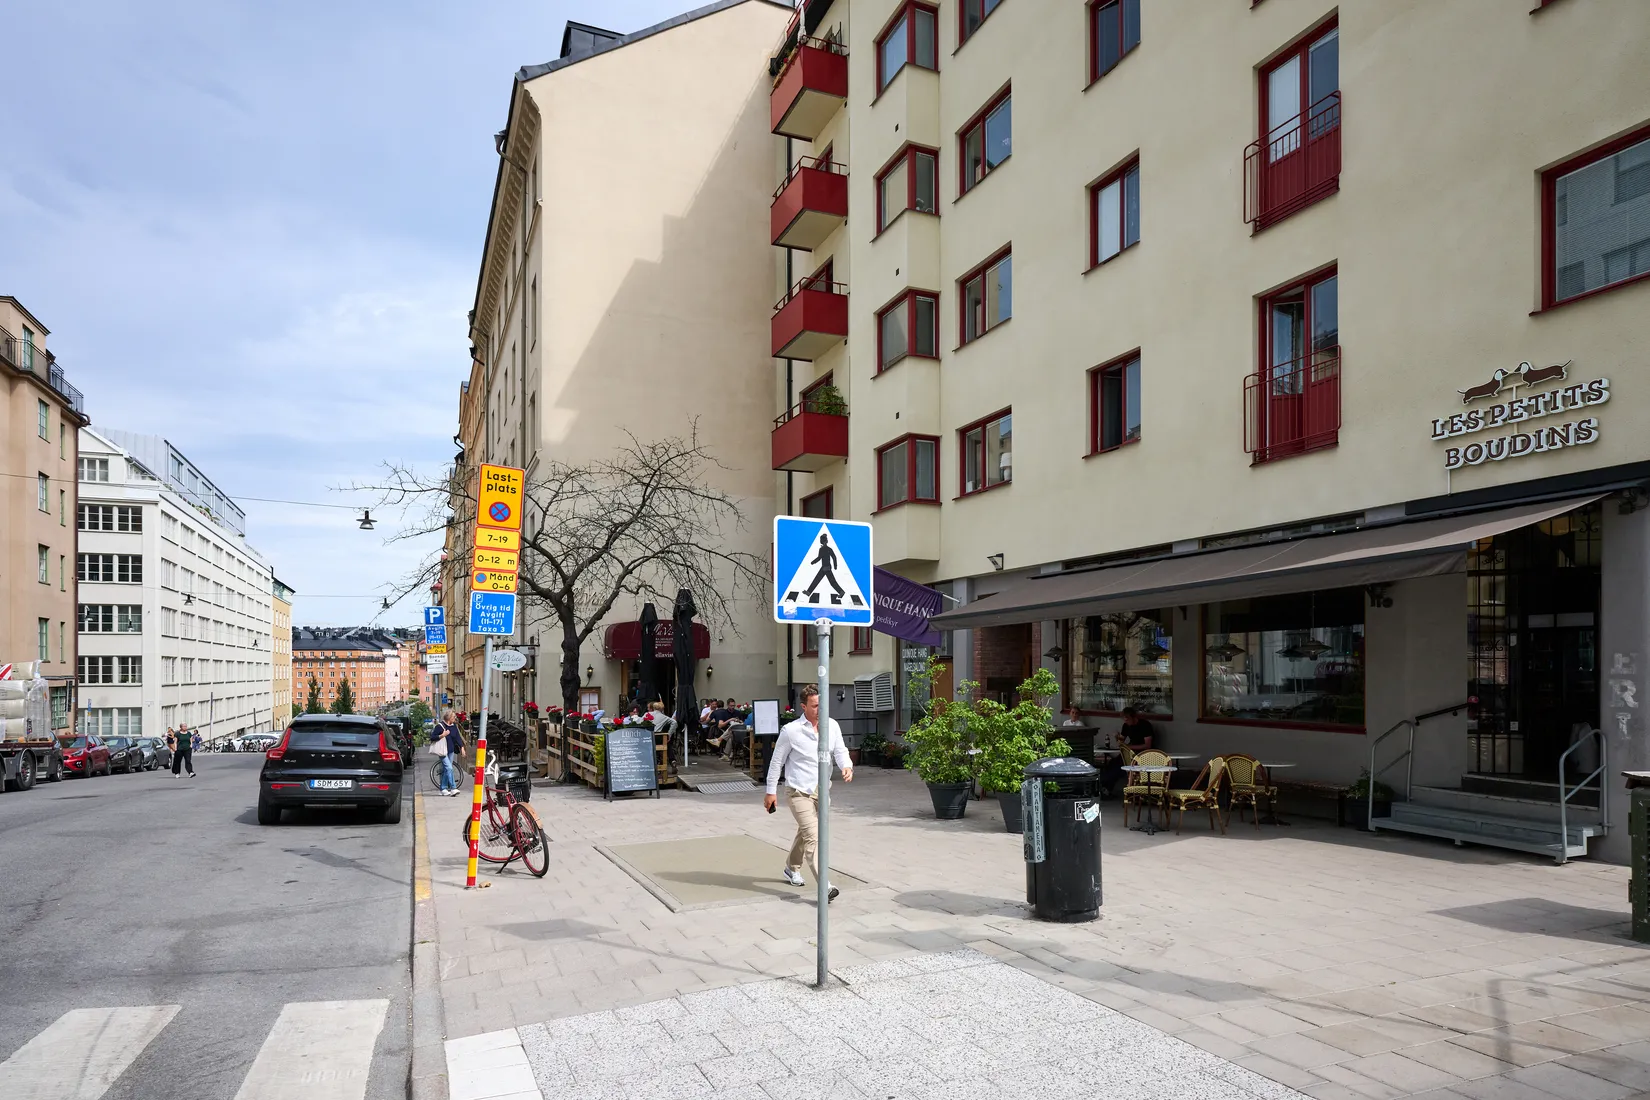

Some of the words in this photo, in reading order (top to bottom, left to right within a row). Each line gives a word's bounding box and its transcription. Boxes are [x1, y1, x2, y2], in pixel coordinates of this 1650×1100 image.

[1431, 408, 1484, 441] LES
[1489, 377, 1611, 427] PETITS
[1444, 417, 1599, 470] BOUDINS
[486, 470, 518, 482] Last-
[486, 483, 517, 494] plats
[487, 534, 508, 544] 7-19
[477, 555, 500, 564] 0-12
[490, 572, 514, 582] Månd
[491, 582, 510, 590] 0-6
[475, 594, 482, 602] P
[873, 592, 904, 613] NIQUE
[475, 602, 498, 612] Övrig
[499, 604, 511, 612] tid
[429, 608, 441, 624] P
[480, 611, 505, 619] Avgift
[876, 615, 899, 628] pedikyr
[1033, 791, 1042, 853] PANTAMERA
